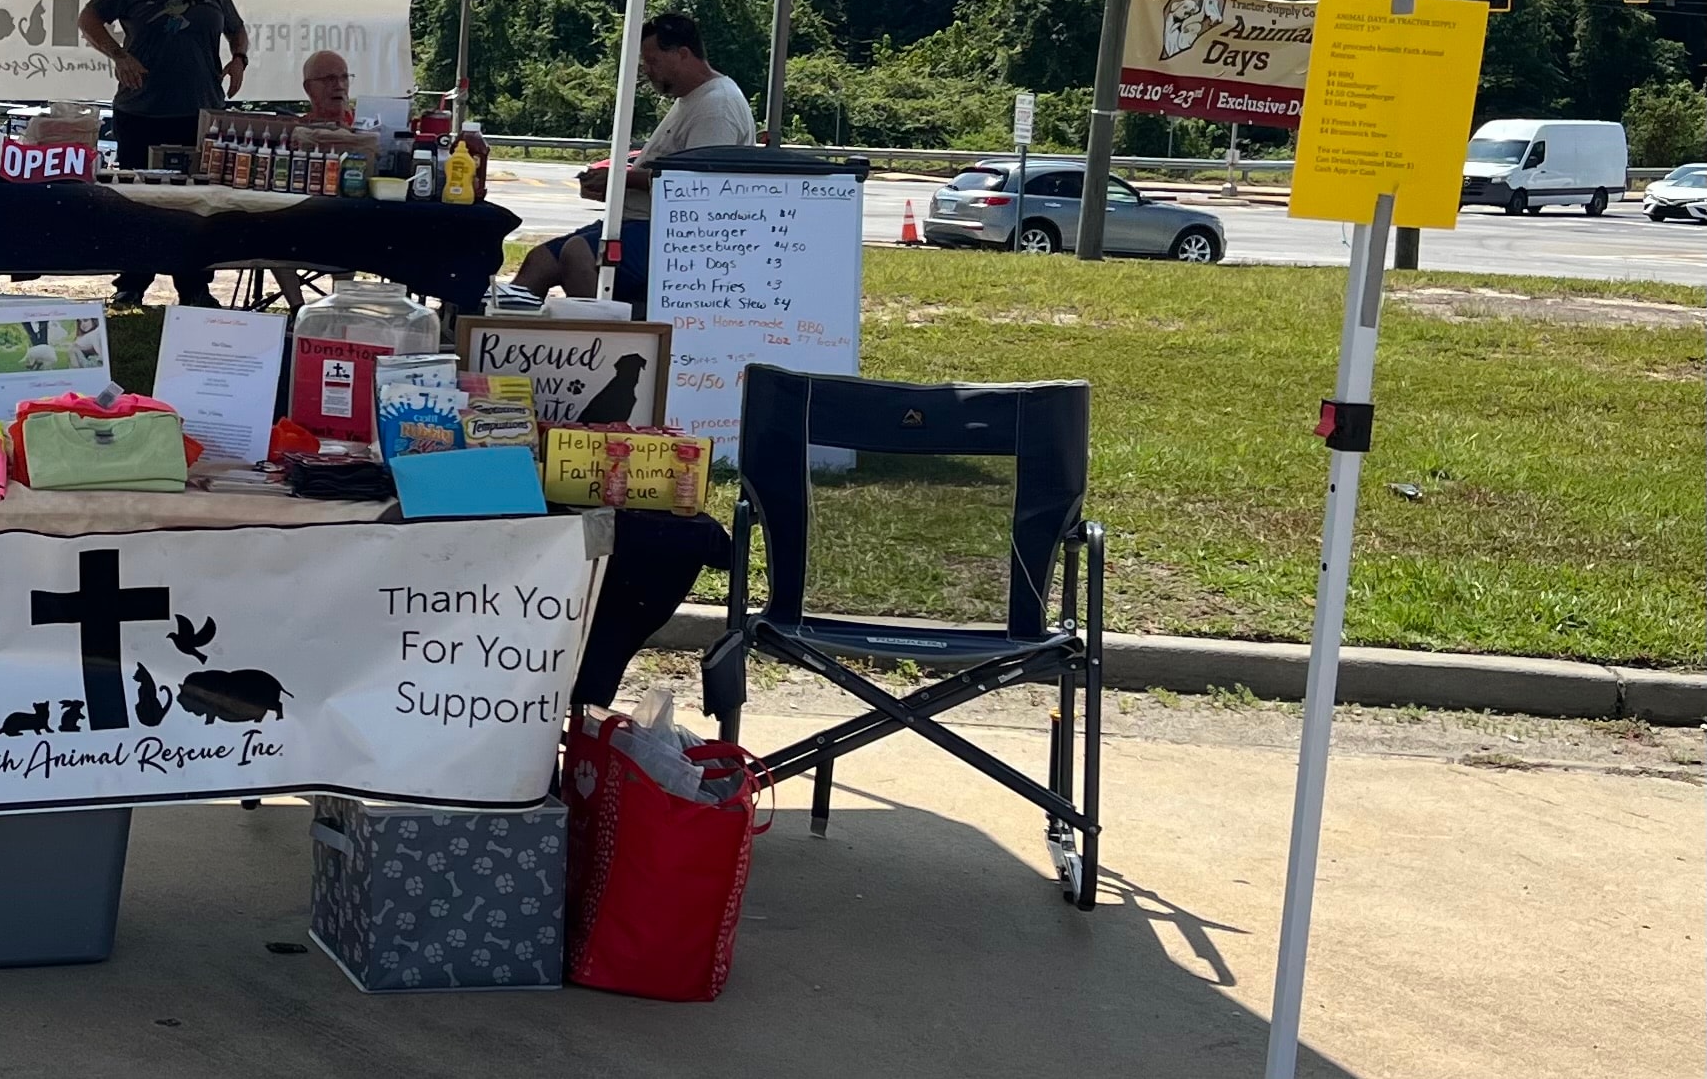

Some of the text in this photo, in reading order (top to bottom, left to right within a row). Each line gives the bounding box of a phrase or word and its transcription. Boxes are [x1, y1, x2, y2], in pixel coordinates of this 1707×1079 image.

[1266, 4, 1300, 19] Supply
[1334, 23, 1364, 31] AUGUST
[1336, 13, 1456, 29] ANIMAL DAYS TRACTOR SUPPLY
[1342, 43, 1376, 51] proceeds
[1202, 39, 1270, 77] Days
[1337, 81, 1380, 91] Hamburger
[1217, 92, 1286, 115] Exclusive
[1346, 91, 1396, 101] Cheeseburger
[1332, 119, 1357, 127] French
[1317, 145, 1330, 154] Tea
[4, 145, 86, 179] OPEN
[663, 179, 856, 199] Faith Animal Rescue
[669, 209, 797, 222] BBQ sandwich $4
[666, 225, 788, 243] Hamburger $4
[663, 243, 761, 256] Cheeseburger
[667, 257, 782, 276] Hot Dogs $3
[662, 281, 706, 292] French
[712, 279, 746, 293] Fries
[661, 296, 792, 311] Brunswick Stew $4
[673, 317, 706, 331] DP's
[796, 321, 824, 335] BBQ
[480, 332, 607, 373] Rescued
[535, 377, 564, 395] MY
[676, 372, 725, 391] 50/50
[471, 420, 528, 435] Temptations
[558, 433, 601, 457] Help
[559, 459, 605, 481] Faith
[589, 482, 659, 499] Rcue
[378, 584, 584, 621] Thank You
[402, 631, 565, 672] For Your
[396, 681, 559, 728] Support!
[23, 741, 130, 779] Animal
[134, 736, 235, 774] Rescue
[238, 729, 284, 767] Inc.
